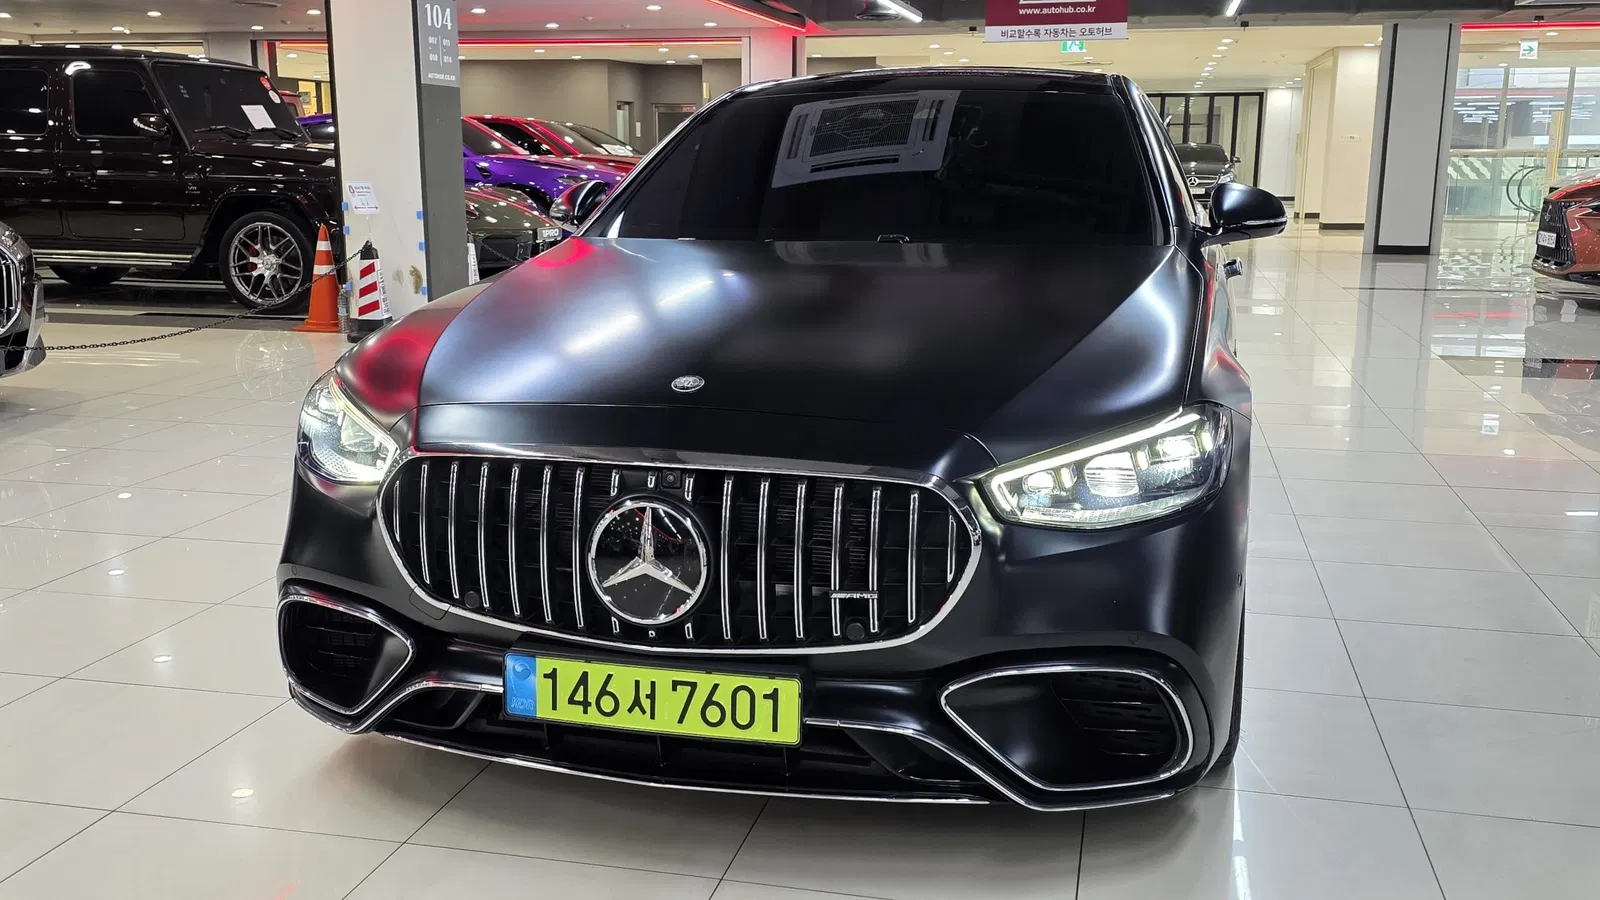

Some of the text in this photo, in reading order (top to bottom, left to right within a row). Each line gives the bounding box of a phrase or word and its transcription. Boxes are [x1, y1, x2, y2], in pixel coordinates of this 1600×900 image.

[424, 3, 452, 30] 104
[1019, 5, 1096, 15] www.autohub.co.kr
[1000, 26, 1113, 39] 비교할수록 자동차는 오토허브
[511, 696, 534, 711] KOR
[542, 667, 779, 733] 146서 7601
